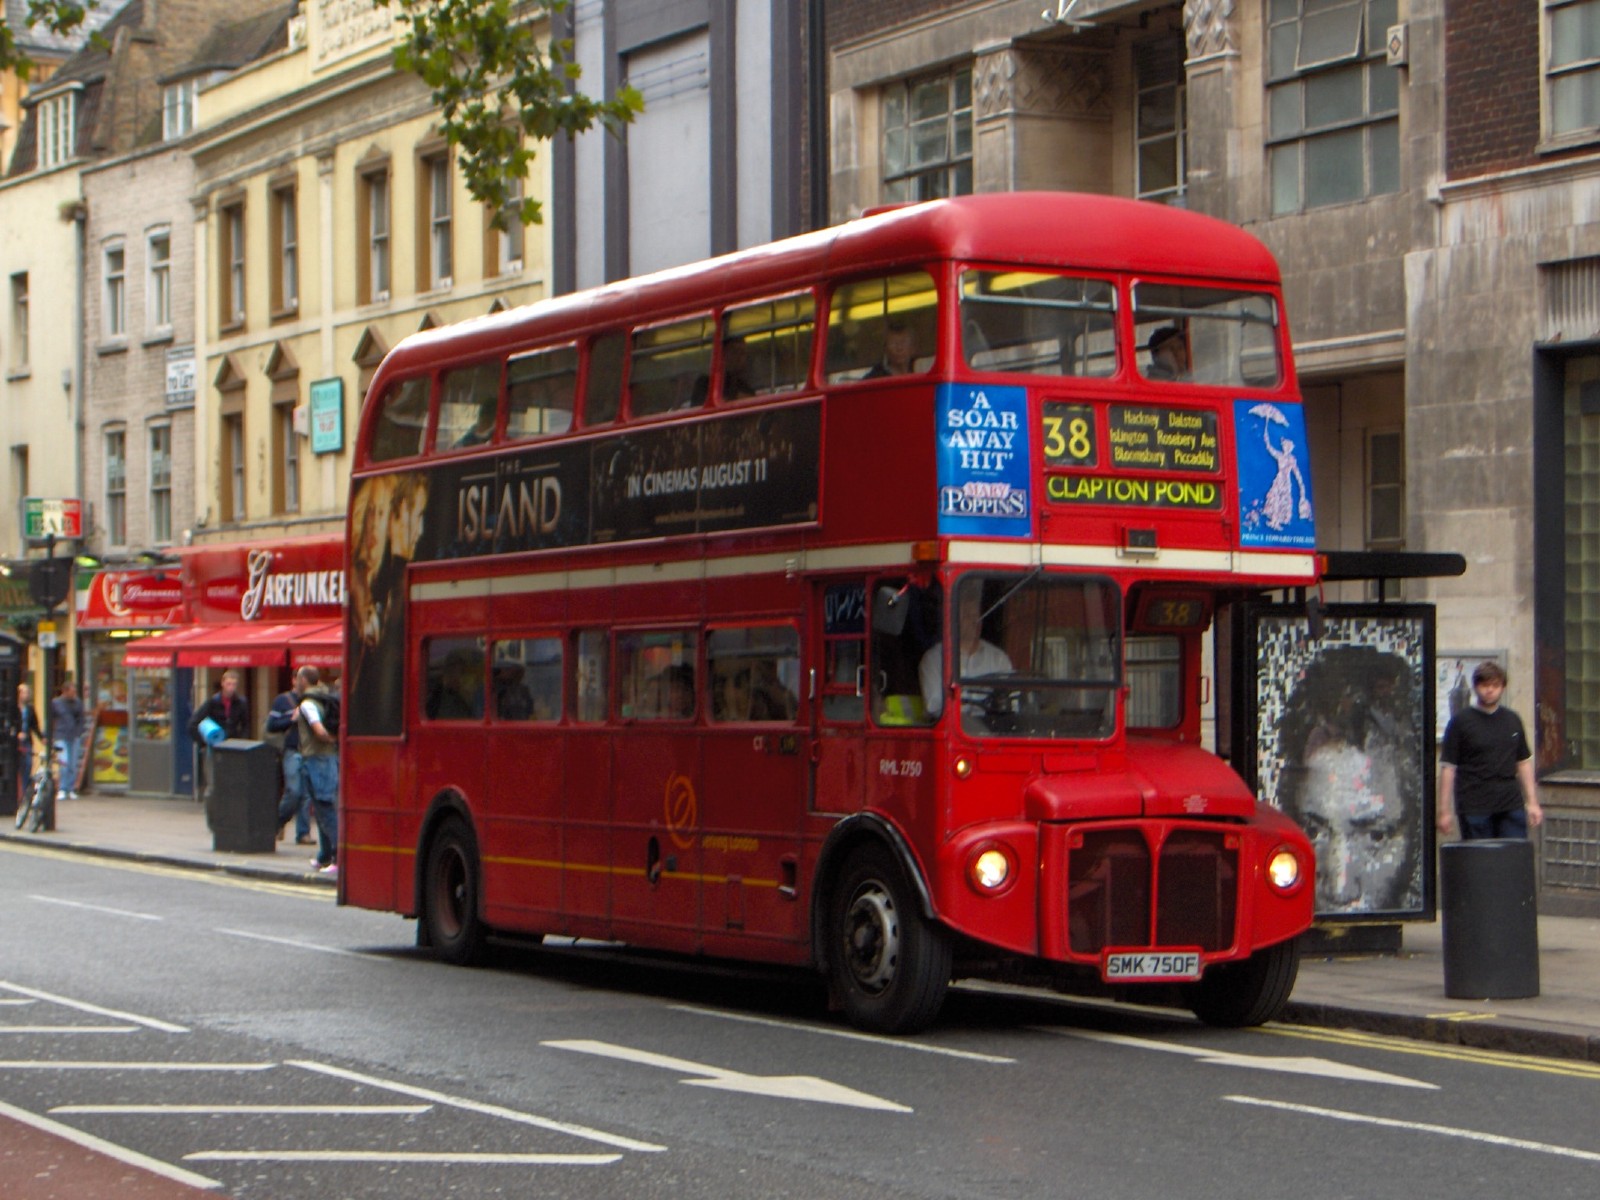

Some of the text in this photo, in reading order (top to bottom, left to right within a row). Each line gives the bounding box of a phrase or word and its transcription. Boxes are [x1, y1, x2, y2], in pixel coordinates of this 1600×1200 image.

[947, 409, 1019, 430] SOAR
[1123, 410, 1203, 430] Hackney Dalston
[948, 429, 1015, 450] AWAY
[1042, 417, 1091, 459] 38
[1110, 428, 1216, 450] Islington Rosebery Ave
[1114, 446, 1214, 469] Bloomsbury Piccadilly
[627, 458, 767, 498] IN CINEMAS AUGUST 11
[963, 482, 1011, 500] MARY
[1048, 476, 1215, 504] CLAPTON POND
[458, 476, 562, 542] ISLAND
[31, 515, 74, 537] BAR
[1162, 601, 1190, 624] 38
[880, 759, 922, 777] RML 2750
[1109, 956, 1197, 974] SMK 750F
